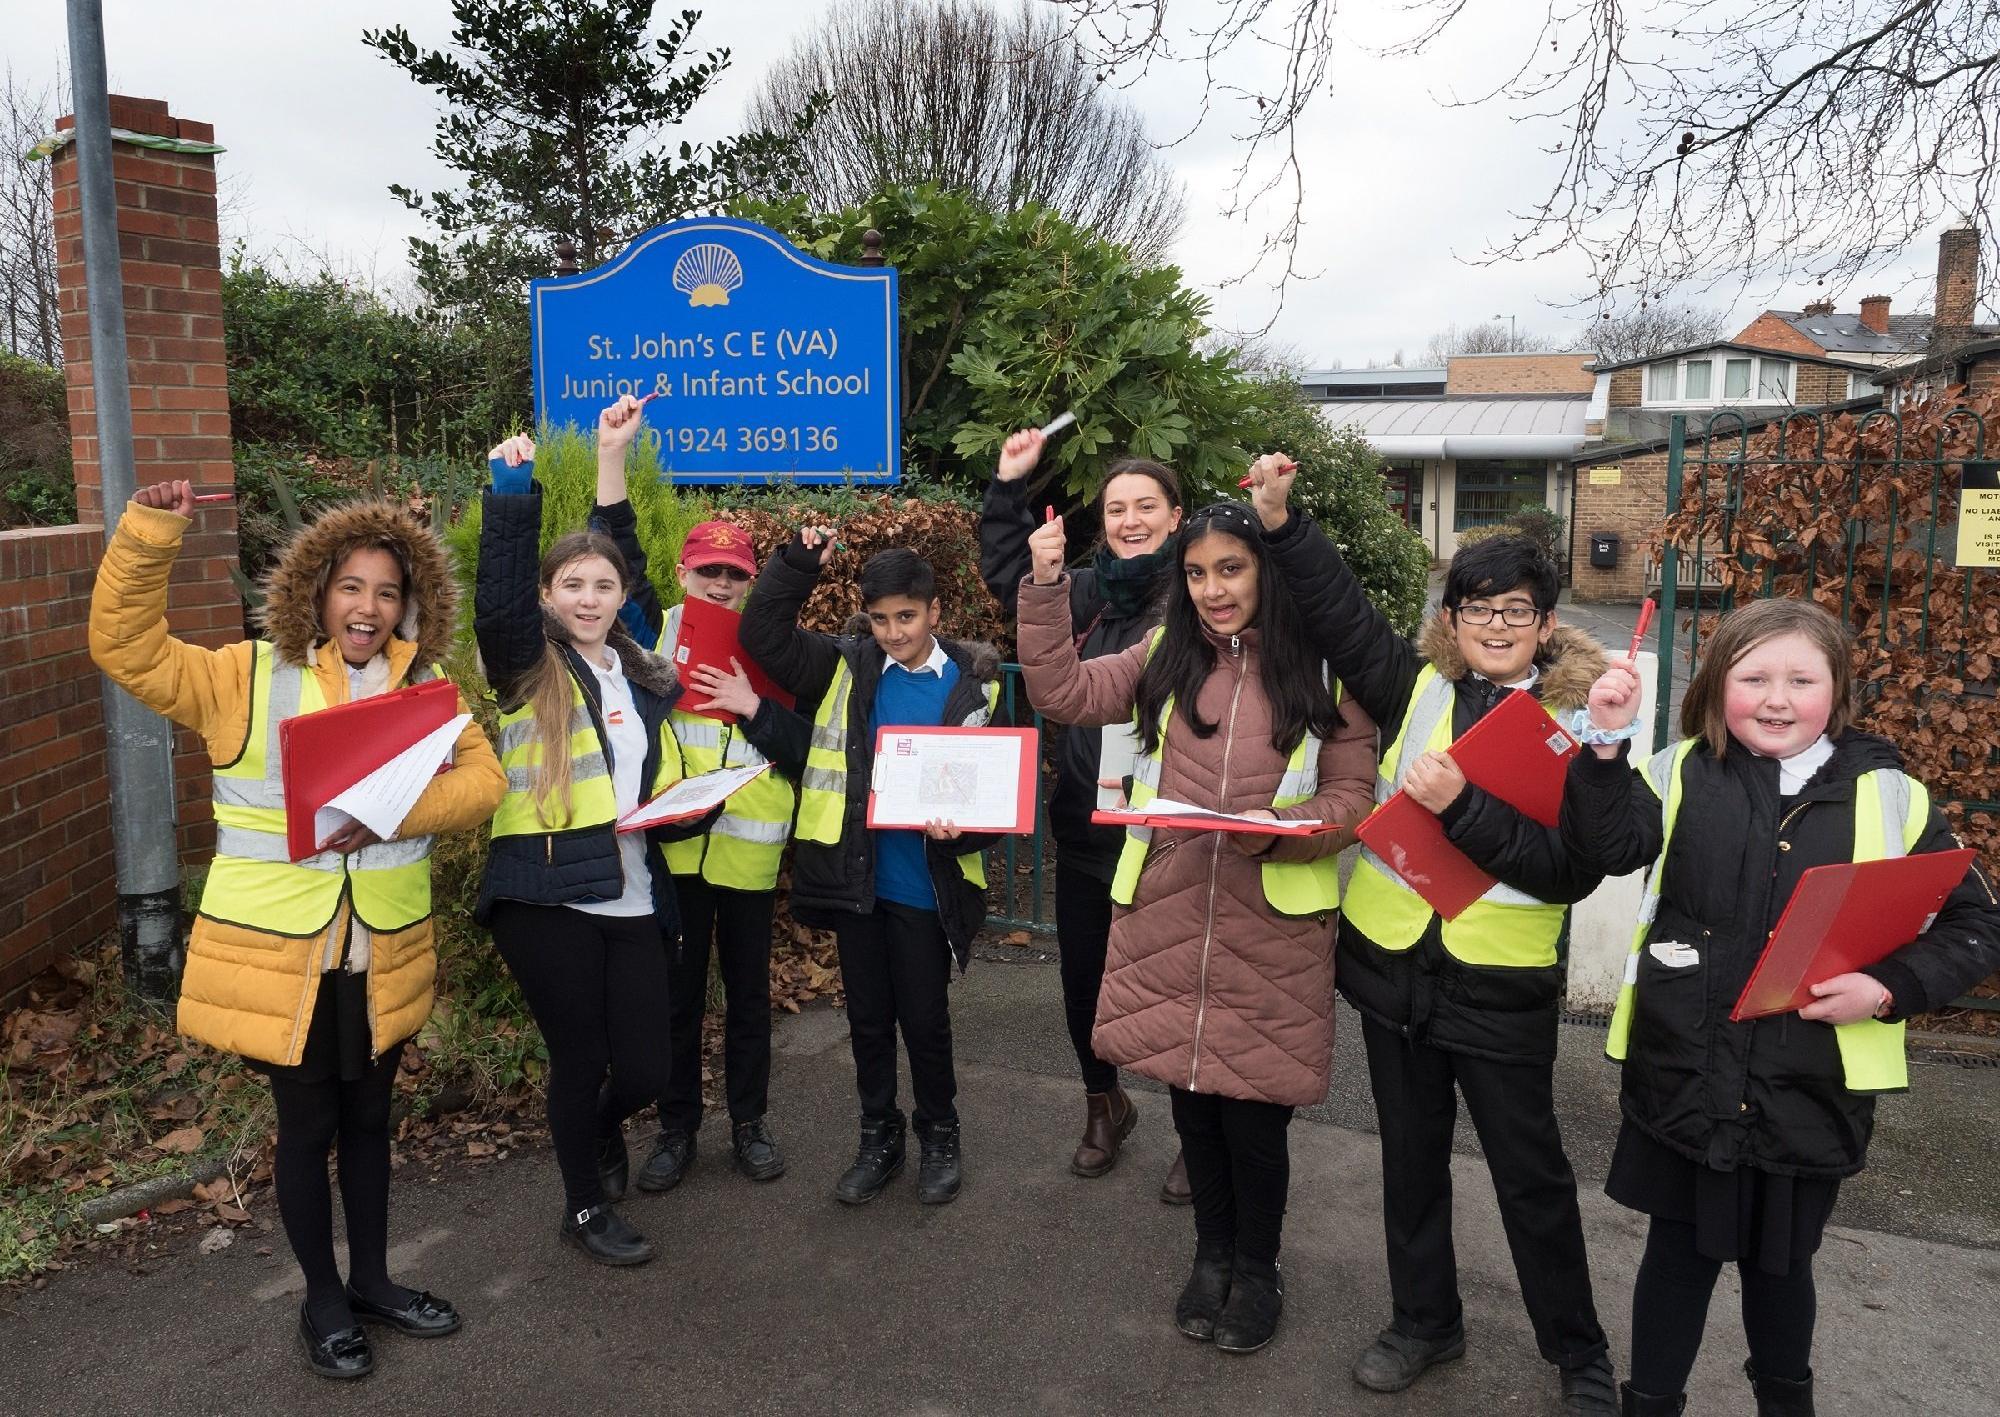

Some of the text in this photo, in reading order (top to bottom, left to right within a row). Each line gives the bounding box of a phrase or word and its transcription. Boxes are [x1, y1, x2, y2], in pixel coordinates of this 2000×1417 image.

[588, 328, 838, 361] St. John's C E (VA)
[561, 367, 869, 399] Junior & Infant School
[651, 425, 838, 453] 01924 369136
